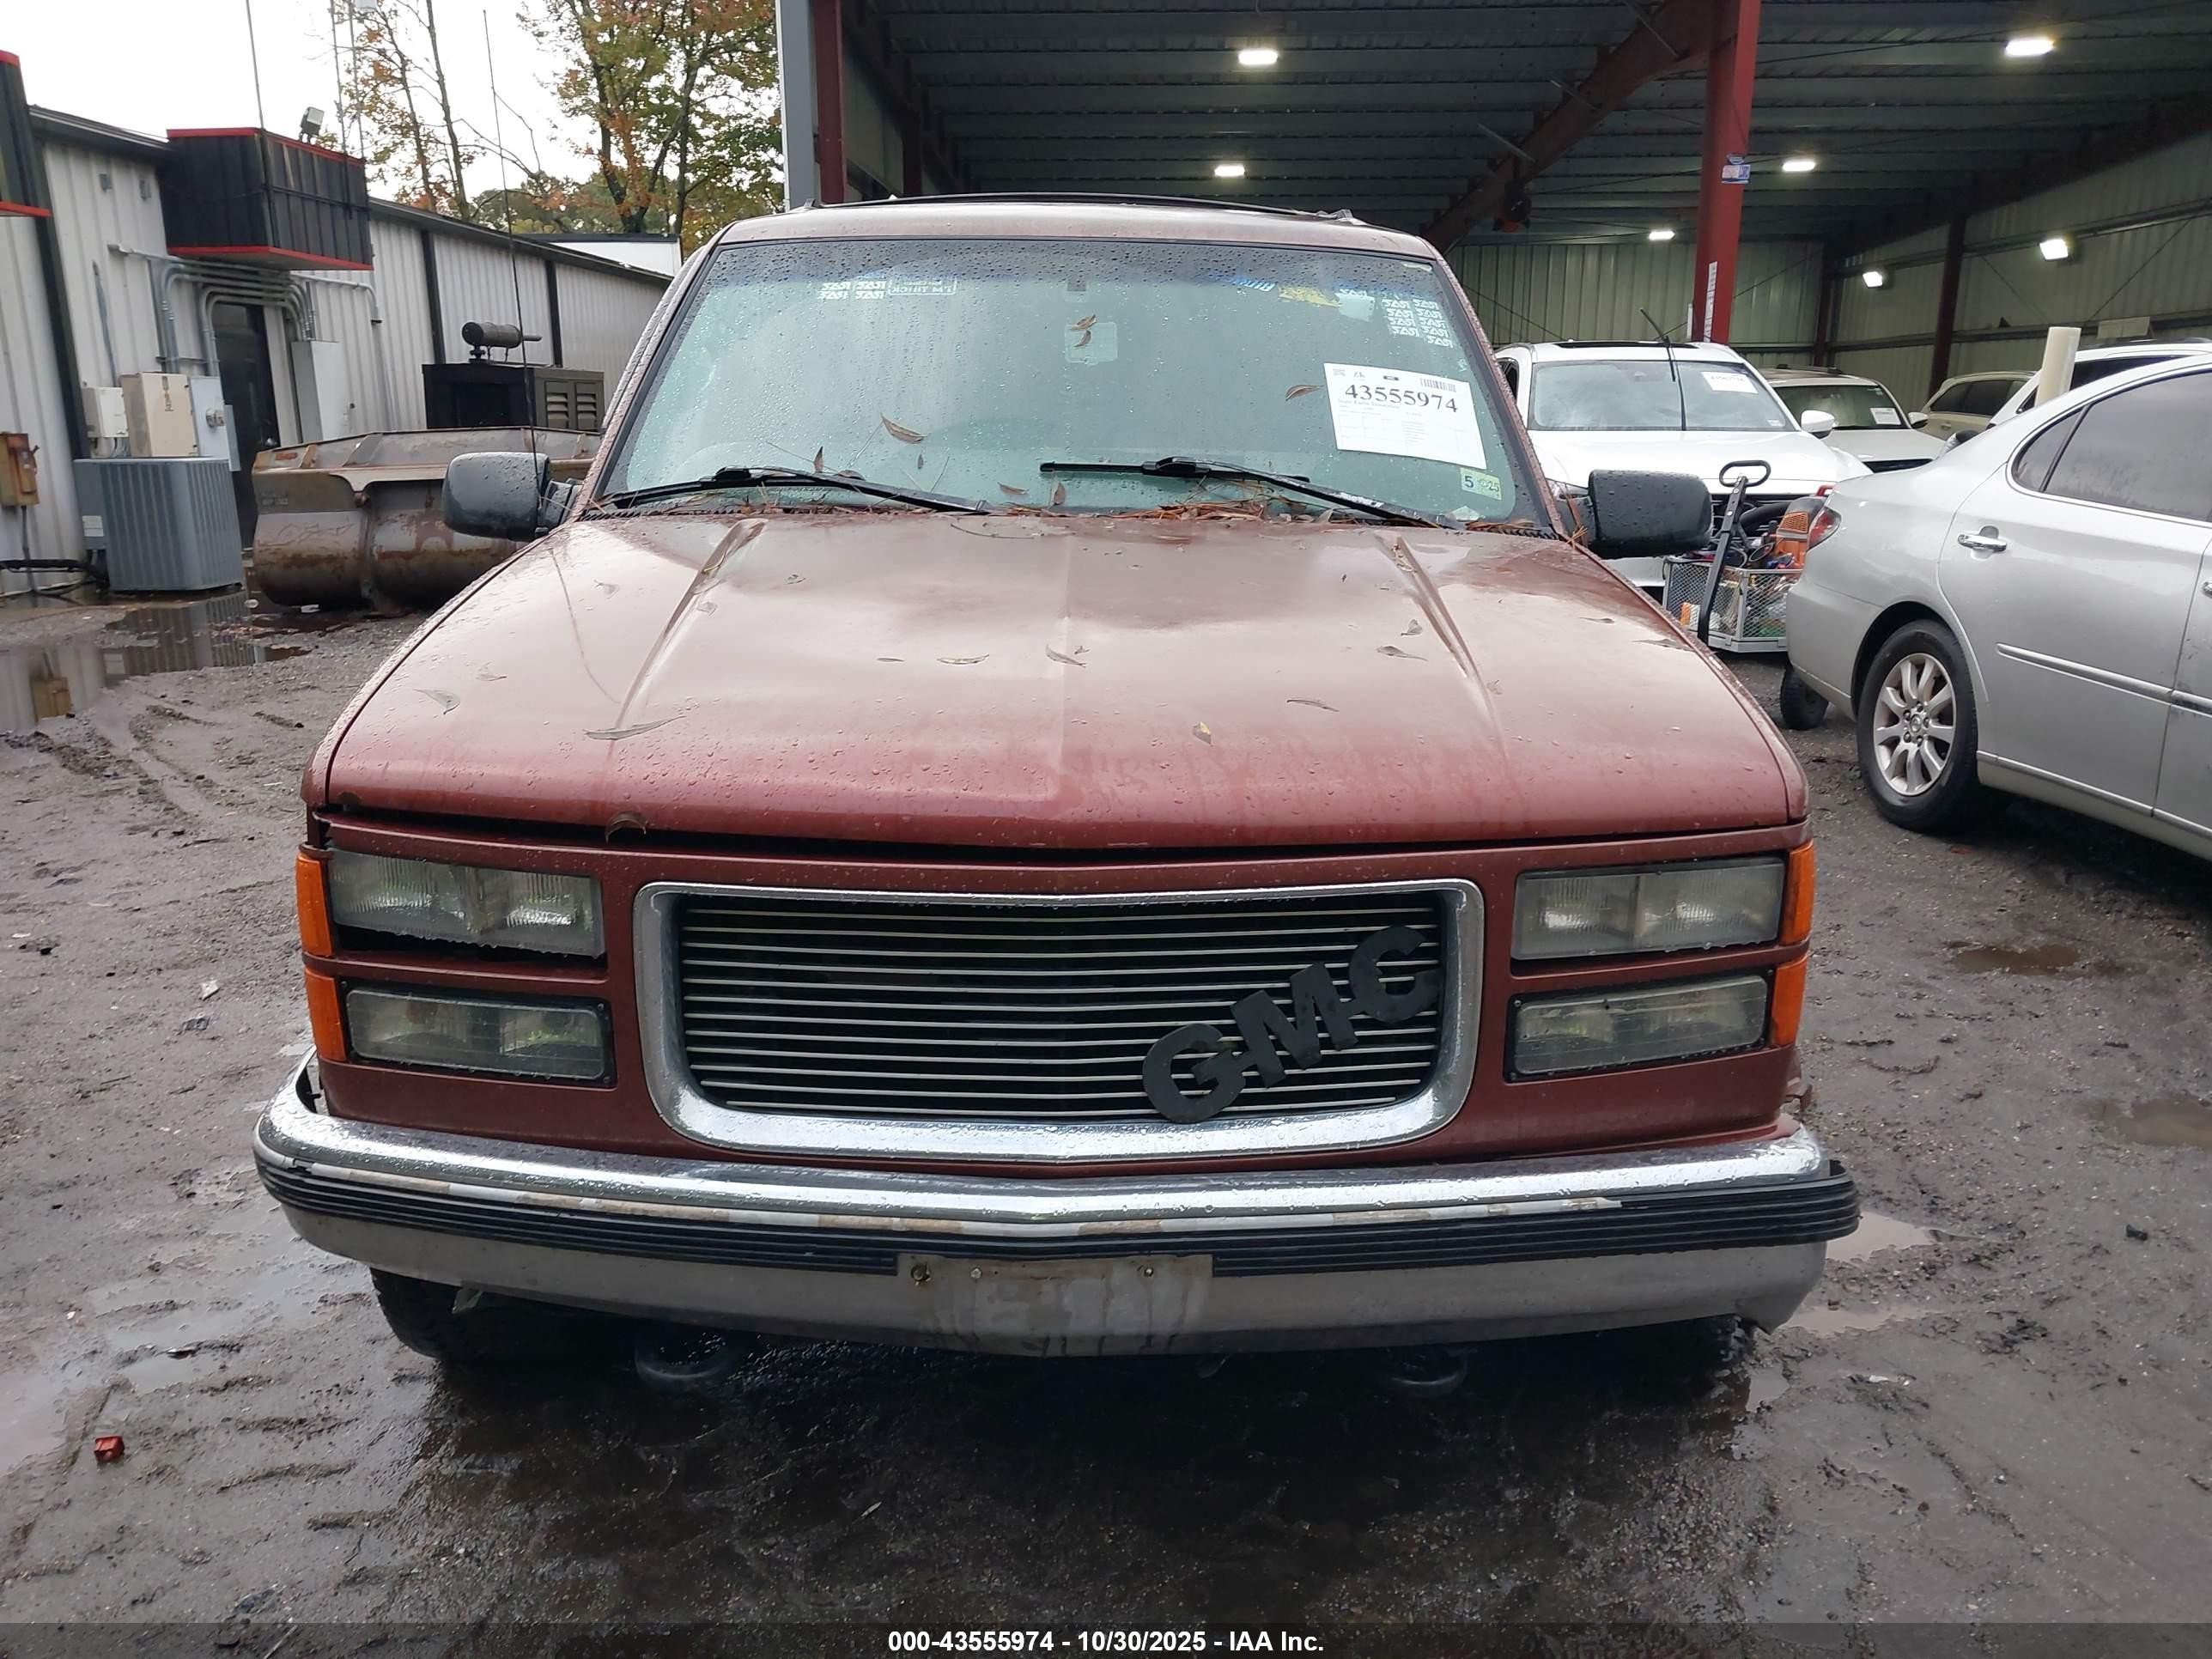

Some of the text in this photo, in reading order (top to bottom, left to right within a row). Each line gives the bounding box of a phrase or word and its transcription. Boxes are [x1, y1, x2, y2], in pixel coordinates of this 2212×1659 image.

[1345, 384, 1458, 413] 43555974
[1464, 475, 1474, 489] 5
[1142, 925, 1441, 1124] GMC
